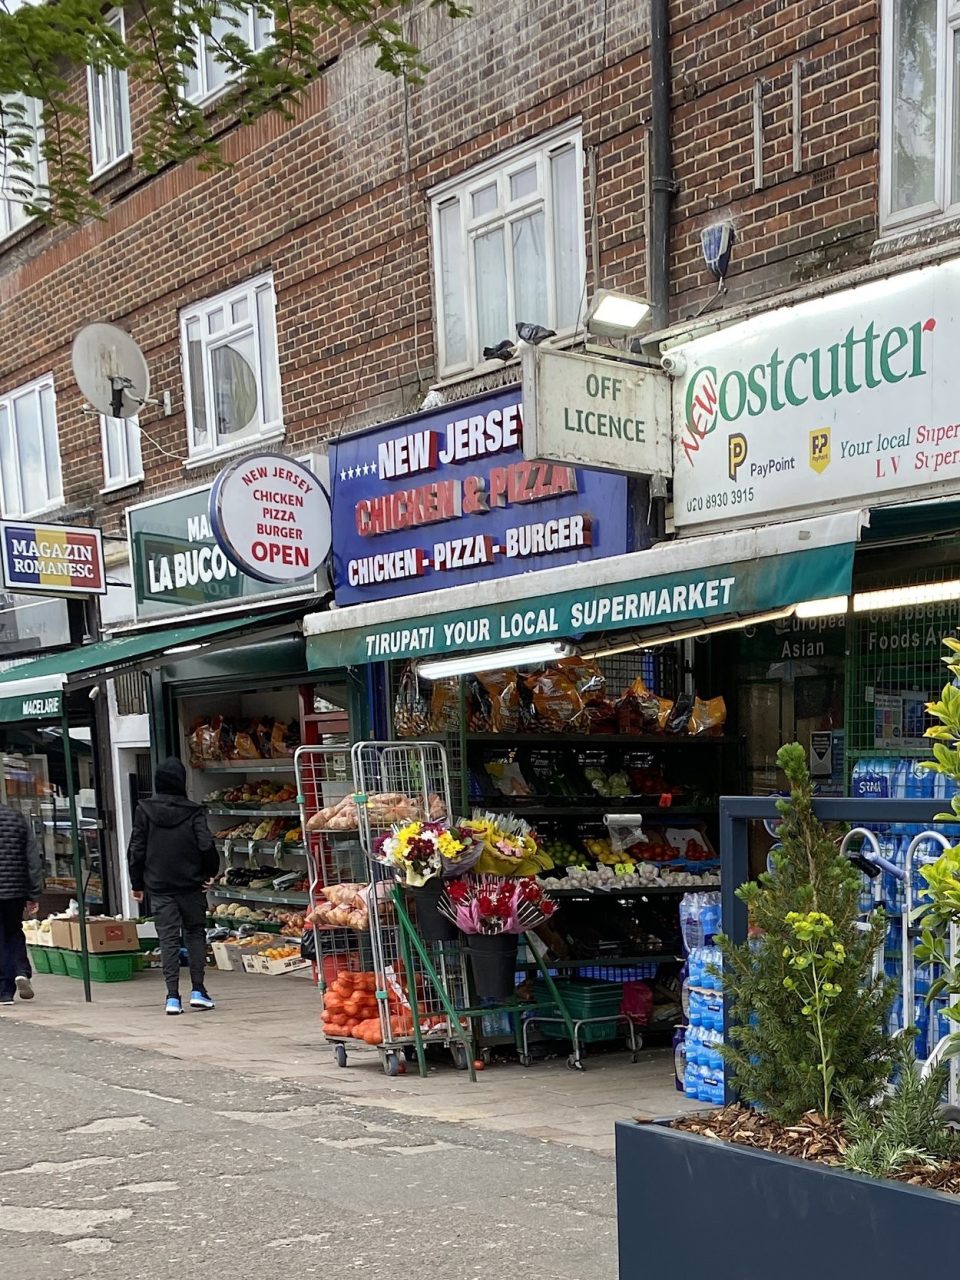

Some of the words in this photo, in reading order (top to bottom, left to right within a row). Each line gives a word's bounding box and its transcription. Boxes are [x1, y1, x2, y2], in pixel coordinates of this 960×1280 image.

[586, 373, 622, 401] OFF
[685, 318, 937, 437] Costcutter
[564, 407, 646, 444] LICENCE
[679, 373, 718, 468] NEW
[378, 429, 434, 481] NEW
[840, 440, 873, 459] Your
[876, 427, 911, 452] local
[241, 466, 268, 487] NEW
[272, 466, 313, 495] JERSEY
[750, 456, 795, 478] PayPoint
[253, 489, 304, 508] CHICKEN
[355, 479, 462, 538] CHICKEN
[490, 461, 577, 507] PIZZA
[705, 491, 728, 509] 8930
[731, 487, 755, 505] 3915
[263, 507, 297, 523] PIZZA
[256, 523, 304, 541] BURGER
[11, 539, 93, 562] MAGAZIN
[251, 541, 310, 567] OPEN
[348, 548, 418, 588] CHICKEN
[434, 534, 488, 573] PIZZA
[506, 515, 585, 559] BURGER
[13, 558, 95, 578] ROMANESC
[149, 556, 174, 593] LA
[174, 544, 244, 588] BUCOV
[366, 626, 434, 656] TIRUPATI
[444, 618, 490, 646] YOUR
[500, 607, 559, 639] LOCAL
[571, 576, 736, 628] SUPERMARKET
[775, 613, 847, 636] Europea
[781, 639, 825, 658] Asian
[868, 630, 920, 651] Foods
